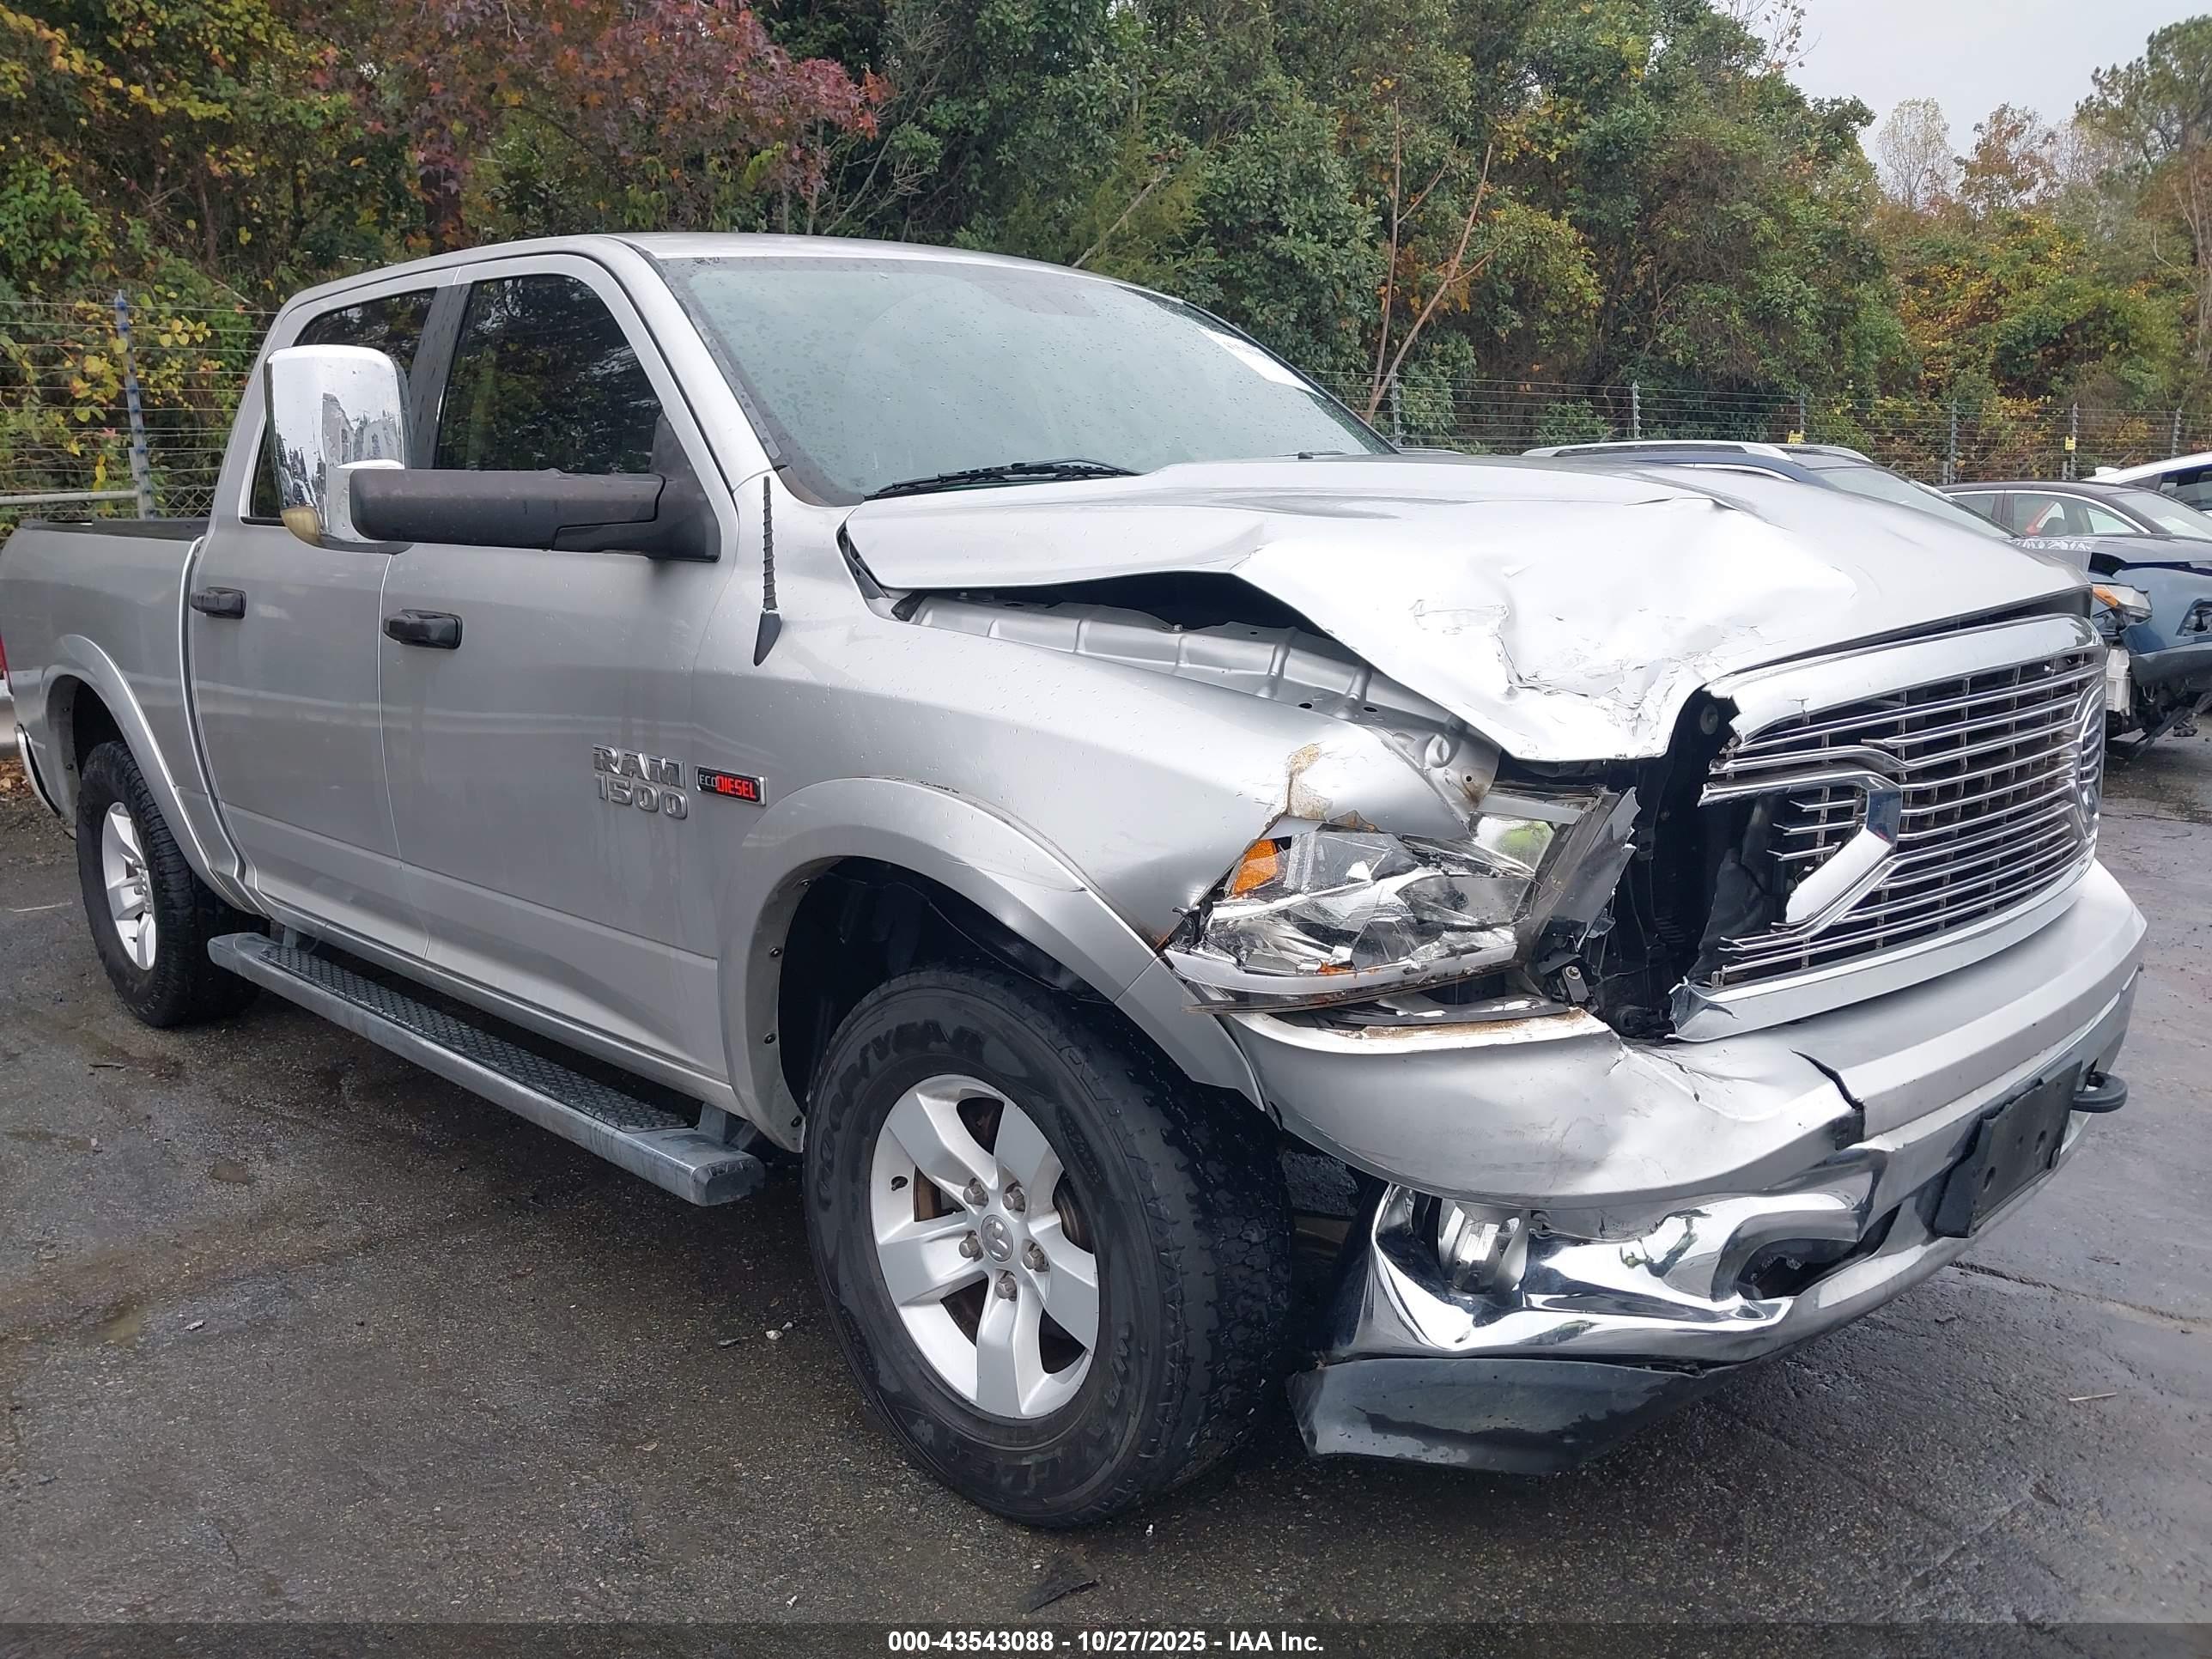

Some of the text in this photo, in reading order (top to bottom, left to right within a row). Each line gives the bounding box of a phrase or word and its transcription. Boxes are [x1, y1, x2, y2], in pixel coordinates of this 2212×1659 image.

[592, 744, 686, 789] RAM
[699, 773, 757, 799] ECODIESEL
[595, 775, 688, 820] 1500
